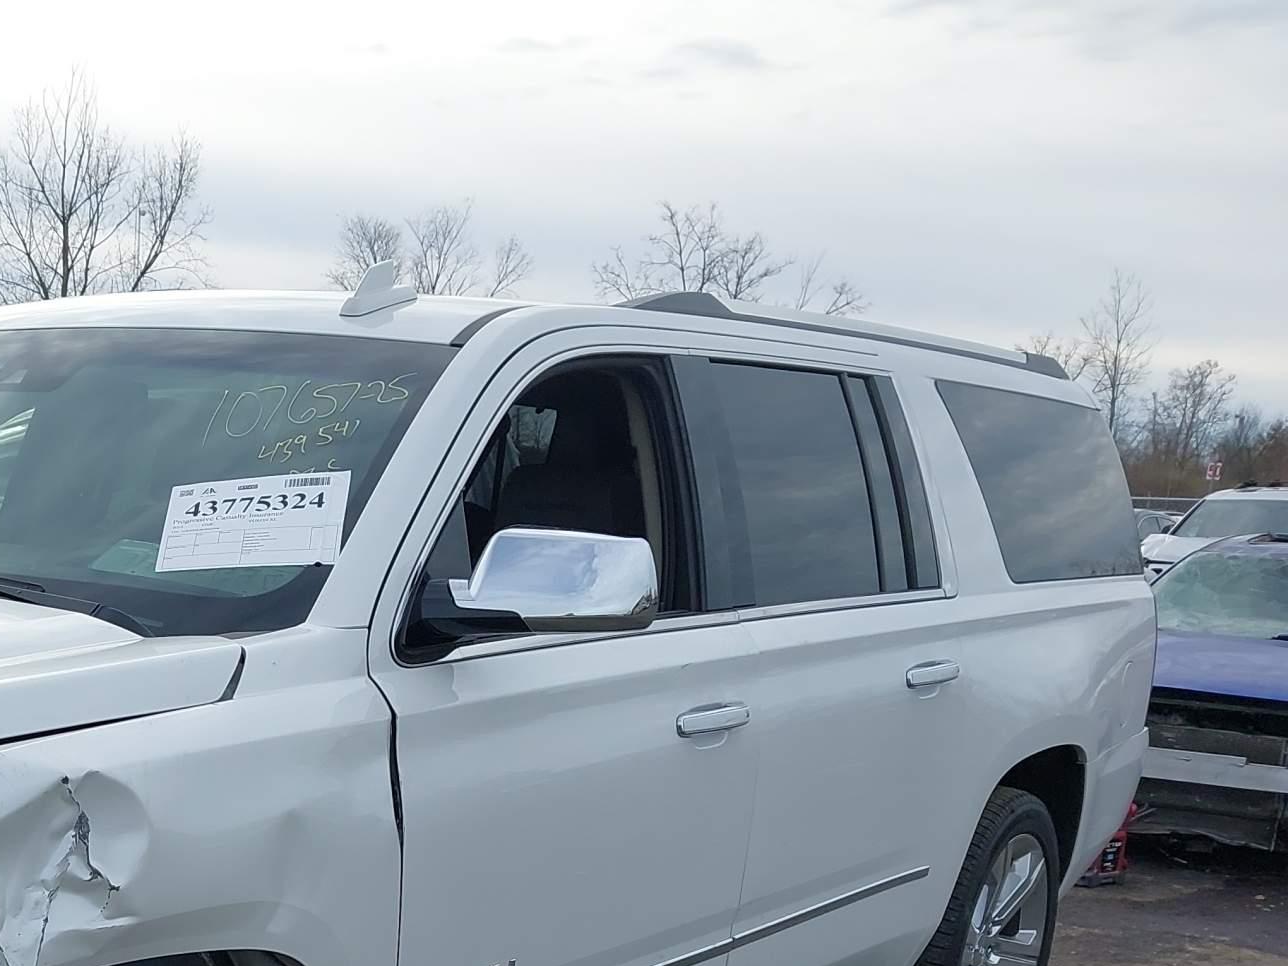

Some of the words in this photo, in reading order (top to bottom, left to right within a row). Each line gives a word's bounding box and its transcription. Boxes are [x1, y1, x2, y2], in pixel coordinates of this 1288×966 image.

[184, 491, 326, 518] 43775324
[172, 516, 214, 526] Progressive
[215, 513, 247, 522] Casualty
[248, 511, 284, 519] Insurance
